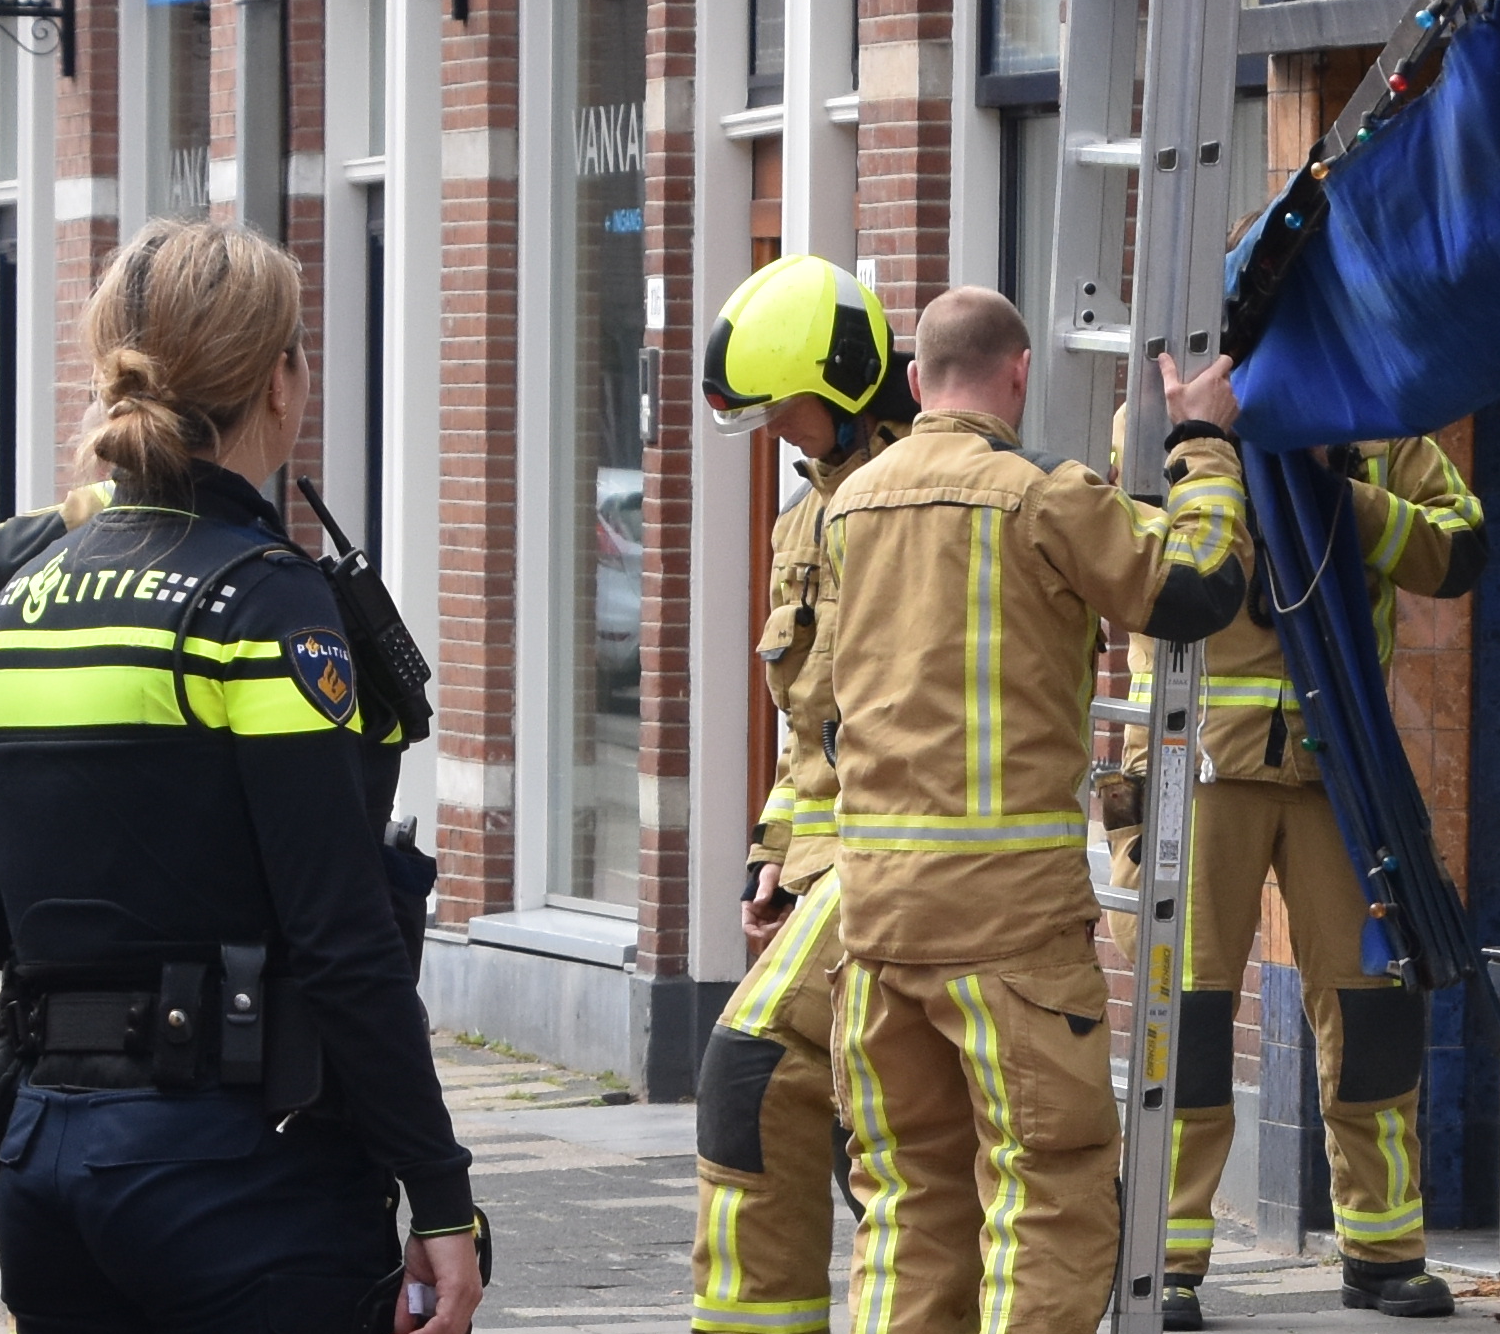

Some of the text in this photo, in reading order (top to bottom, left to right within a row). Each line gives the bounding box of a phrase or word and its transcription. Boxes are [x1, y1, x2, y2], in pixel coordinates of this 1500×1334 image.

[572, 101, 646, 176] VANKA
[7, 549, 167, 624] POLITIE
[296, 640, 349, 661] POLITIE
